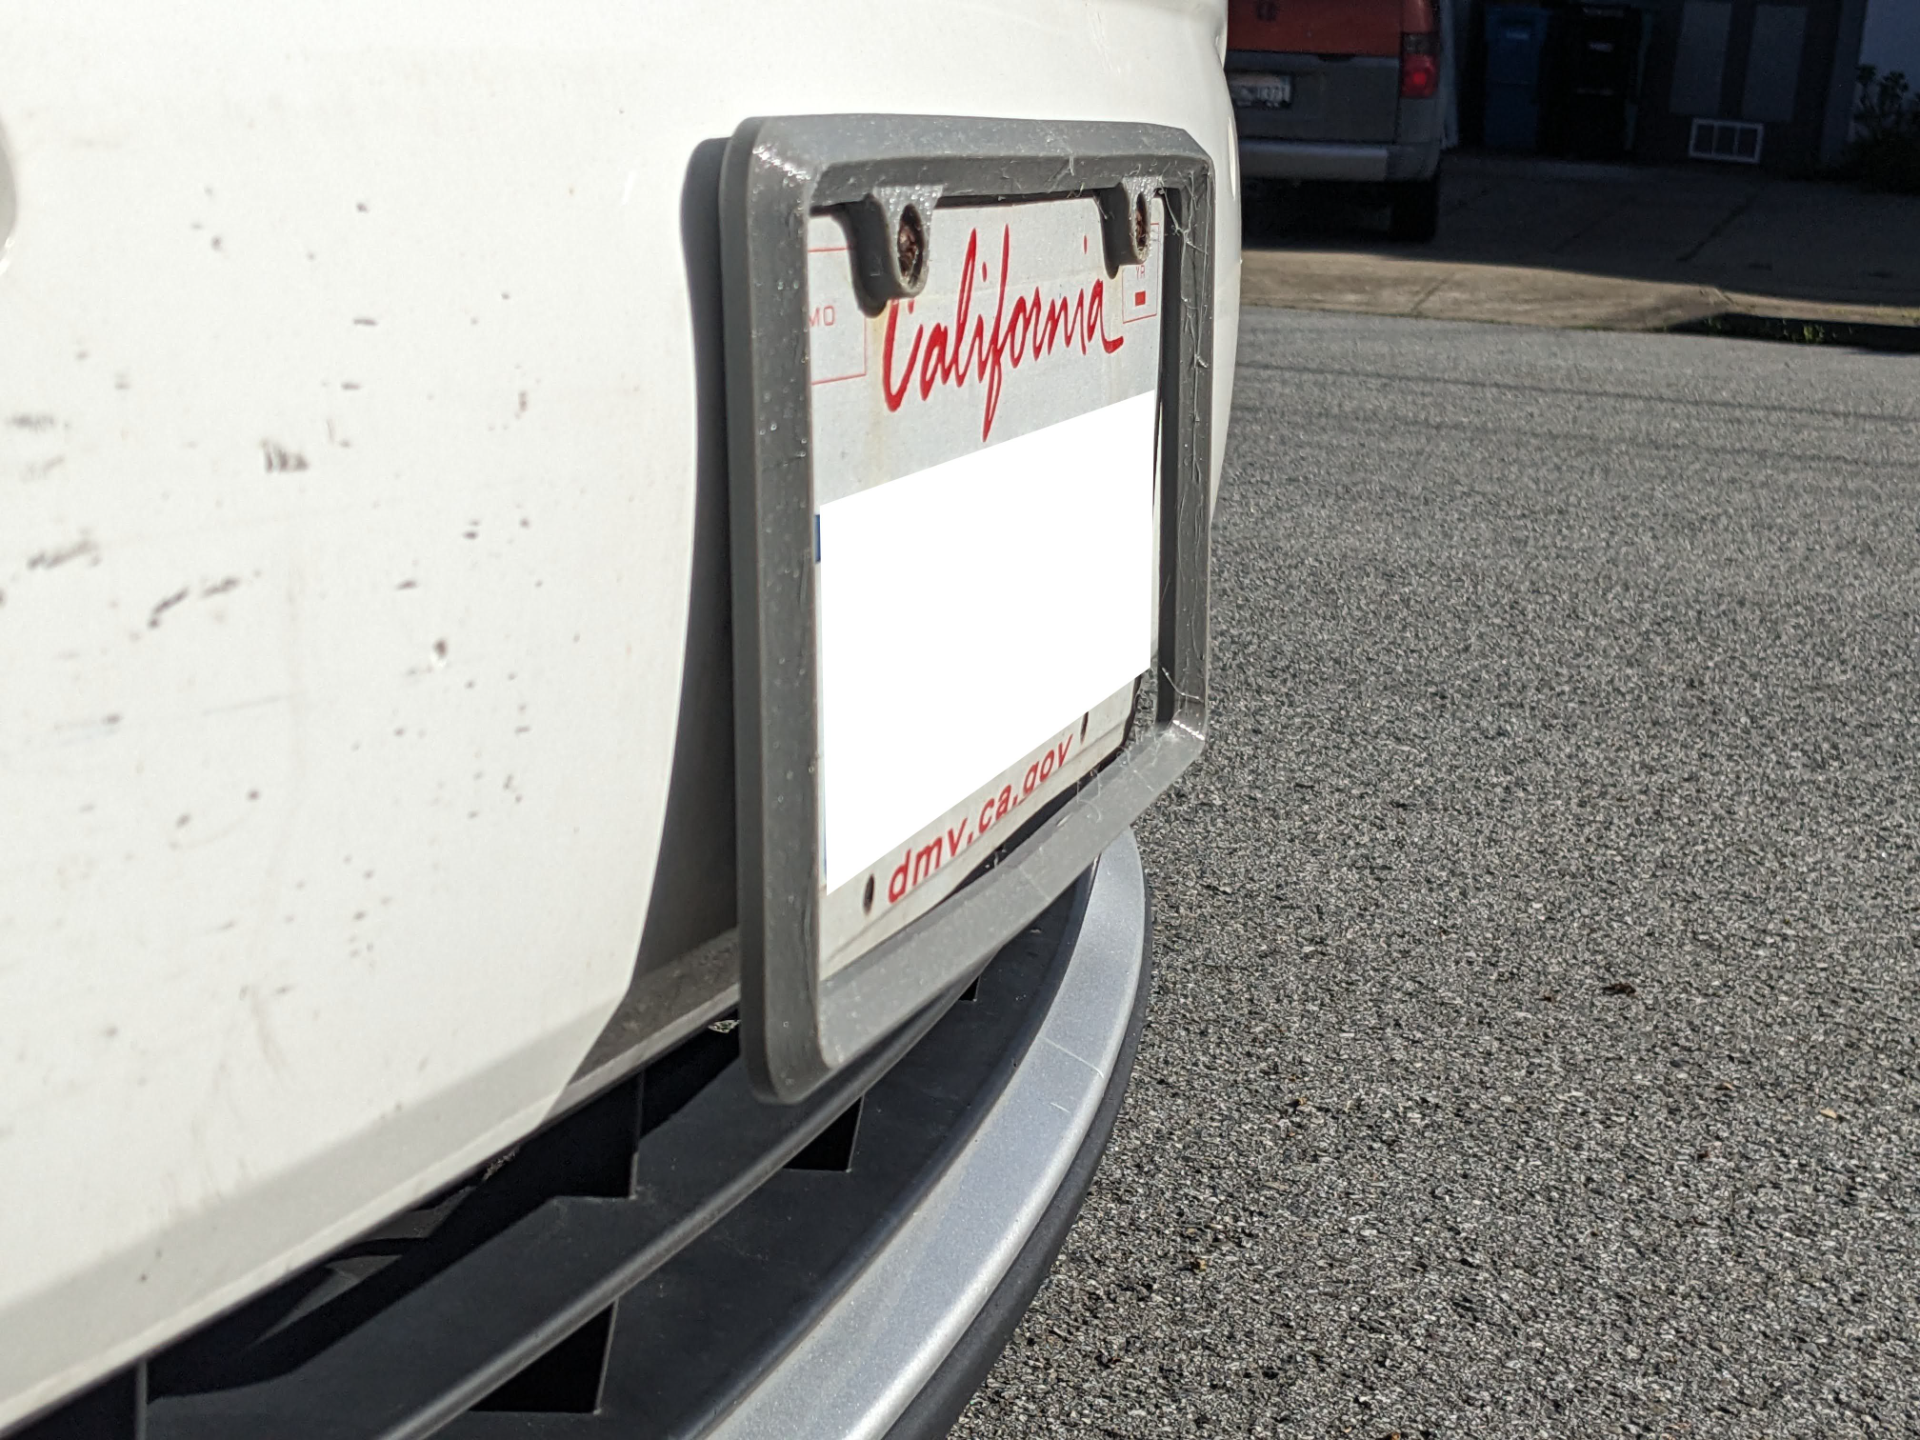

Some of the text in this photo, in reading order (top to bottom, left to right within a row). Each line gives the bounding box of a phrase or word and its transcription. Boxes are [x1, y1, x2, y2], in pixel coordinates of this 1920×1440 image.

[808, 304, 836, 327] MO
[882, 223, 1123, 442] California
[887, 734, 1074, 904] dmv.ca.gov
